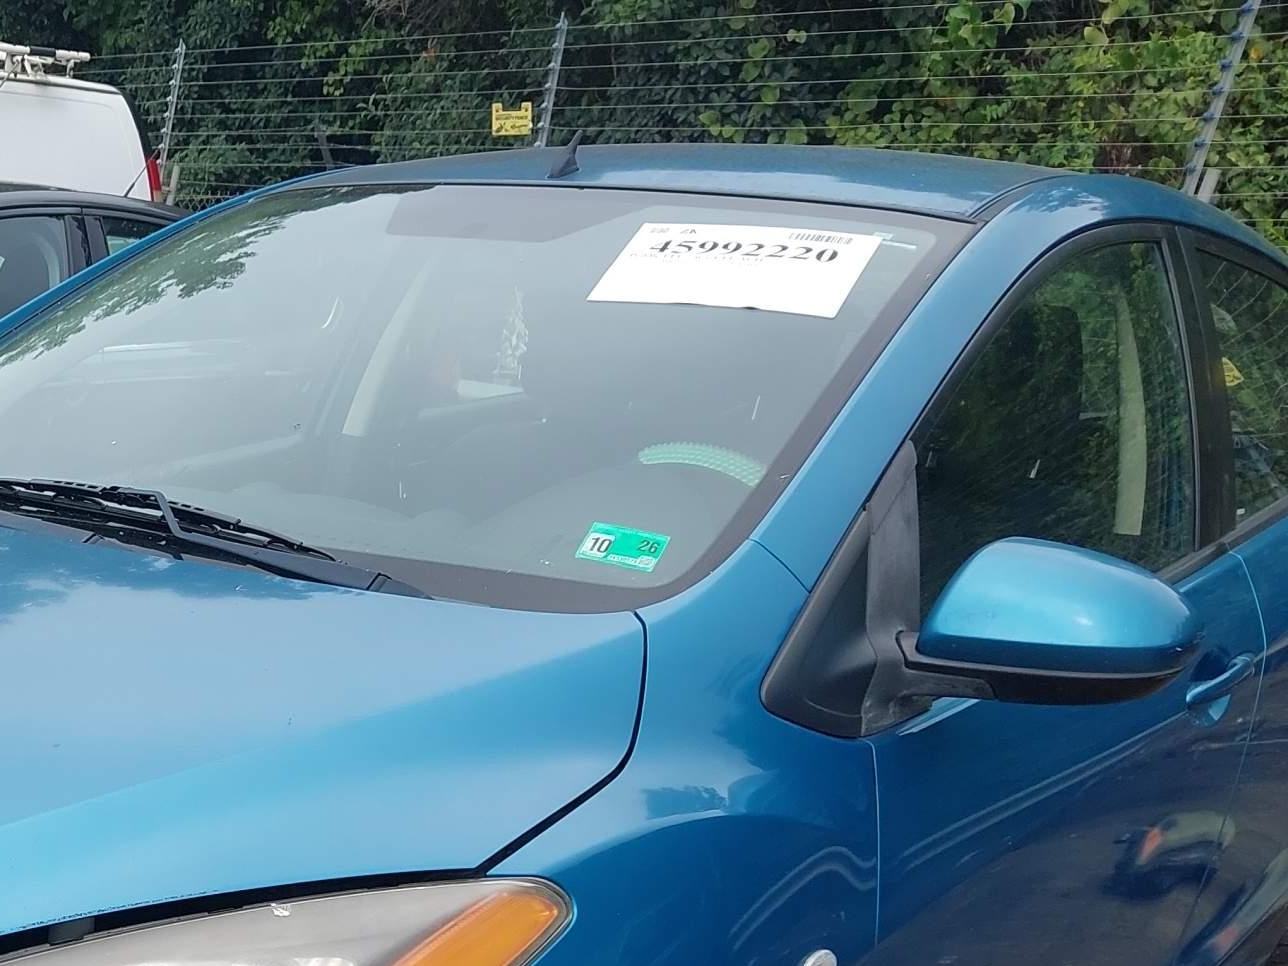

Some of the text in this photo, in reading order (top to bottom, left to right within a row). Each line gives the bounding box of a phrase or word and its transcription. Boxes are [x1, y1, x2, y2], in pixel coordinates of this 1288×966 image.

[649, 239, 839, 263] 45992220
[589, 536, 661, 554] 10 26
